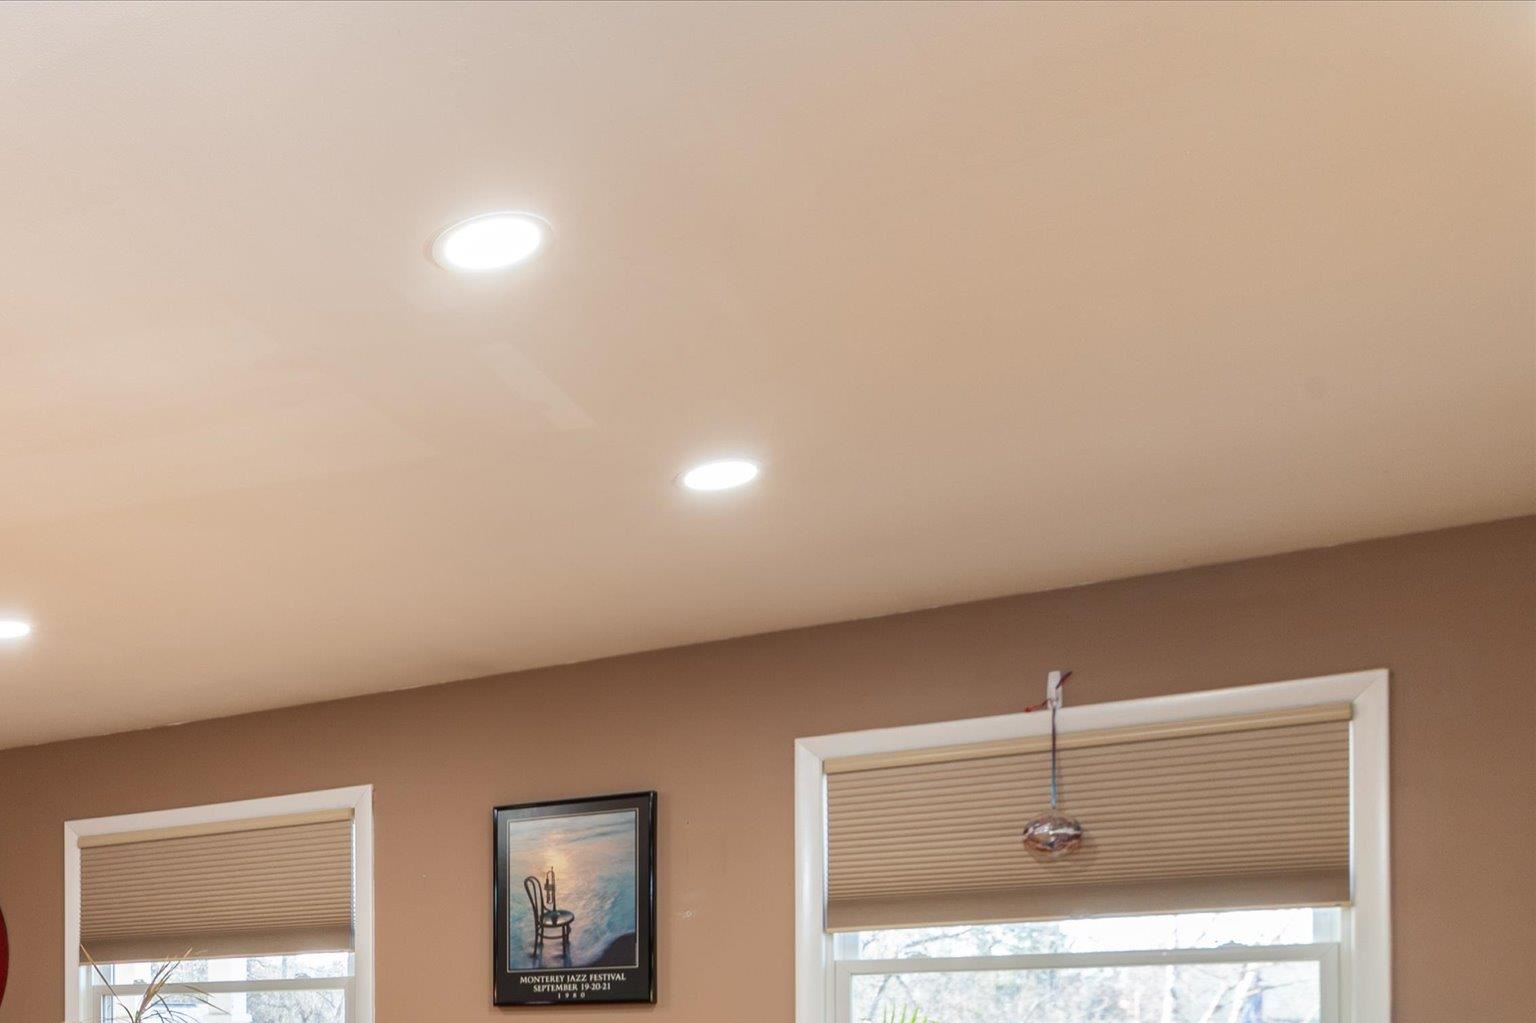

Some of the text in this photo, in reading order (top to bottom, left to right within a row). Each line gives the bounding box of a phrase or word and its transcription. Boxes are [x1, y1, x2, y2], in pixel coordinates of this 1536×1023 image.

[520, 973, 626, 984] MONTEREY JAZZ FESTIVAL
[533, 983, 578, 993] SEPTEMBER
